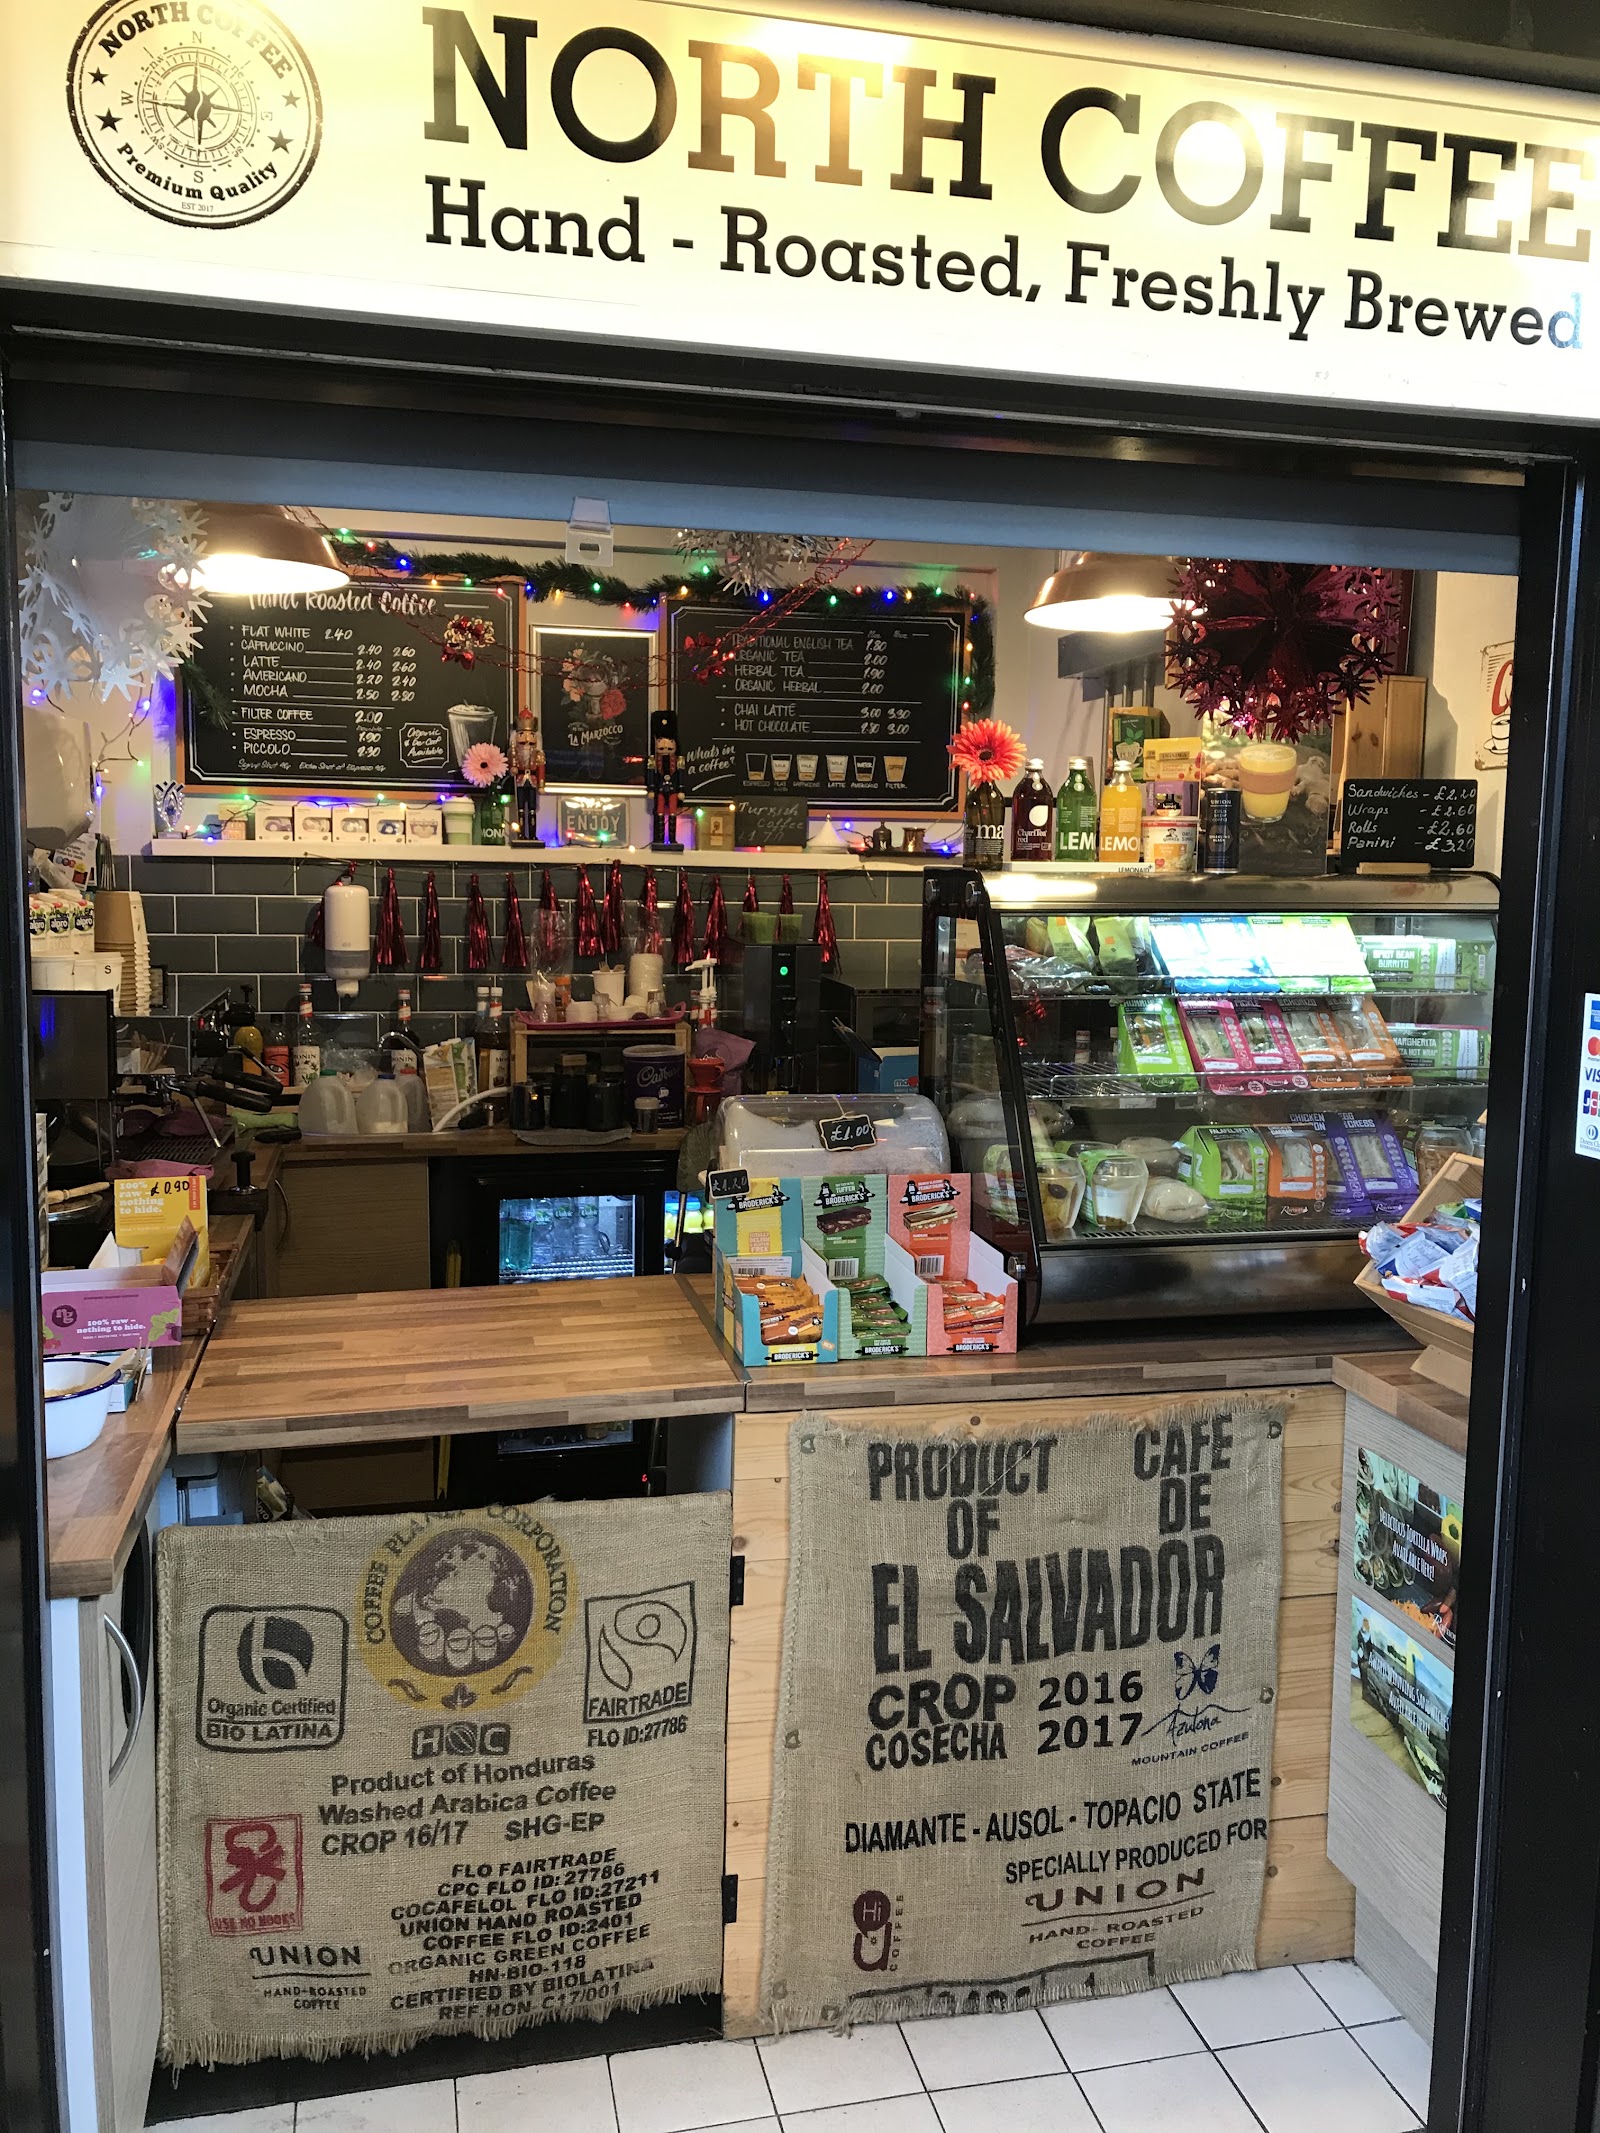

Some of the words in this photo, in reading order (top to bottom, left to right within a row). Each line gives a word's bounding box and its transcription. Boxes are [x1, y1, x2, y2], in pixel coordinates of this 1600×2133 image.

[98, 2, 190, 57] NORTH
[422, 6, 996, 200] NORTH
[1041, 86, 1597, 263] COFFEE
[117, 142, 202, 200] Premium
[210, 162, 278, 200] Quality
[182, 202, 196, 211] EST
[198, 204, 214, 213] 2017
[425, 174, 645, 264] Hand
[720, 205, 1041, 303] Roasted,
[1065, 241, 1324, 342] Freshly
[1345, 269, 1583, 350] Brewed
[305, 590, 373, 612] Roasted
[380, 591, 437, 616] Coffee
[241, 625, 270, 638] FLAT
[274, 626, 311, 638] WHITE
[324, 628, 353, 641] 2.40
[241, 641, 304, 653] CAPPUCCINO
[357, 644, 382, 656] 2.40
[835, 639, 854, 650] TEA
[243, 655, 280, 668] LATTE
[356, 659, 382, 671] 2.40
[782, 651, 805, 663] TEA
[243, 668, 307, 683] AMERICANO
[734, 665, 777, 678] HERBAL
[781, 666, 805, 678] TEA
[243, 684, 288, 697] MOCHA
[735, 680, 776, 692] ORGANIC
[783, 682, 822, 694] HERBAL
[241, 707, 273, 720] FILTER
[276, 709, 313, 721] COFFEE
[734, 703, 758, 716] CHAI
[763, 703, 797, 716] LATTE
[244, 728, 296, 741] ESPRESSO
[734, 719, 754, 732] HOT
[758, 721, 810, 733] CHOCOLATE
[244, 743, 290, 755] PICCOLO
[722, 744, 736, 755] in
[688, 767, 696, 775] a
[1348, 784, 1418, 799] Sandwiches
[1348, 804, 1389, 816] Wraps
[566, 814, 620, 832] ENJOY
[1348, 822, 1378, 834] Rolls
[1060, 831, 1096, 850] LEM
[1347, 836, 1396, 850] Panini
[50, 918, 68, 931] alpro
[76, 916, 92, 929] alpro
[104, 965, 112, 974] S
[830, 1122, 870, 1142] £1.00
[119, 1181, 147, 1190] 100%
[120, 1197, 164, 1207] nothing
[738, 1196, 779, 1210] BRODERICK'S
[825, 1191, 865, 1206] BRODERICK'S
[912, 1190, 950, 1203] BRODERICK'S
[120, 1206, 136, 1215] to
[76, 1325, 112, 1335] nothing
[114, 1324, 122, 1332] to
[864, 1345, 899, 1354] BRODERICK'S
[1133, 1412, 1233, 1480] CAFE
[868, 1438, 1058, 1501] PRODUCT
[1159, 1473, 1211, 1535] DE
[946, 1499, 1000, 1559] OF
[486, 1505, 568, 1634] CORPORATION
[364, 1560, 388, 1644] COFFEE
[872, 1562, 932, 1674] EL
[953, 1534, 1226, 1666] SALVADOR
[206, 1697, 268, 1720] Organic
[271, 1697, 336, 1717] Certified
[589, 1682, 688, 1718] FAIRTRADE
[866, 1672, 1017, 1731] CROP
[1038, 1670, 1143, 1712] 2016
[206, 1723, 246, 1742] BIO
[251, 1721, 333, 1742] LATINA
[588, 1728, 619, 1748] FLO
[864, 1722, 1008, 1772] COSECHA
[1036, 1711, 1143, 1756] 2017
[1131, 1747, 1197, 1766] MOUNTAIN
[1201, 1731, 1250, 1753] COFFEE
[331, 1769, 436, 1798] Product
[442, 1762, 467, 1786] of
[473, 1752, 595, 1784] Honduras
[318, 1799, 424, 1827] Washed
[430, 1791, 528, 1817] Arabica
[534, 1782, 617, 1806] Coffee
[845, 1812, 966, 1854] DIAMANTE
[985, 1806, 1064, 1843] AUSOL
[1084, 1790, 1182, 1830] TOPACIO
[1192, 1766, 1262, 1813] STATE
[321, 1830, 397, 1857] CROP
[404, 1820, 468, 1848] 16/17
[506, 1811, 606, 1842] SHG-EP
[1005, 1850, 1110, 1885] SPECIALLY
[1116, 1828, 1221, 1876] PRODUCED
[1226, 1818, 1268, 1846] FOR
[452, 1864, 492, 1878] FLO
[499, 1848, 617, 1877] FAIRTRADE
[438, 1882, 480, 1897] CPC
[486, 1878, 526, 1895] FLO
[1025, 1868, 1206, 1914] UNION
[390, 1897, 517, 1921] COCAFELOL
[527, 1890, 567, 1908] FLO
[400, 1917, 470, 1937] UNION
[477, 1912, 537, 1931] HAND
[544, 1892, 642, 1924] ROASTED
[862, 1901, 882, 1922] Hi
[1106, 1906, 1204, 1933] ROASTED
[423, 1932, 505, 1951] COFFEE
[512, 1928, 552, 1945] FLO
[494, 1942, 564, 1964] GREEN
[572, 1923, 652, 1951] COFFEE
[1077, 1932, 1156, 1950] COFFEE
[250, 1945, 362, 1966] UNION
[264, 1985, 366, 1998] HAND-ROASTED
[390, 1984, 502, 2010] CERTIFIED
[508, 1981, 537, 1999] BY
[542, 1958, 654, 1992] BIOLATINA
[294, 1999, 340, 2010] COFFEE
